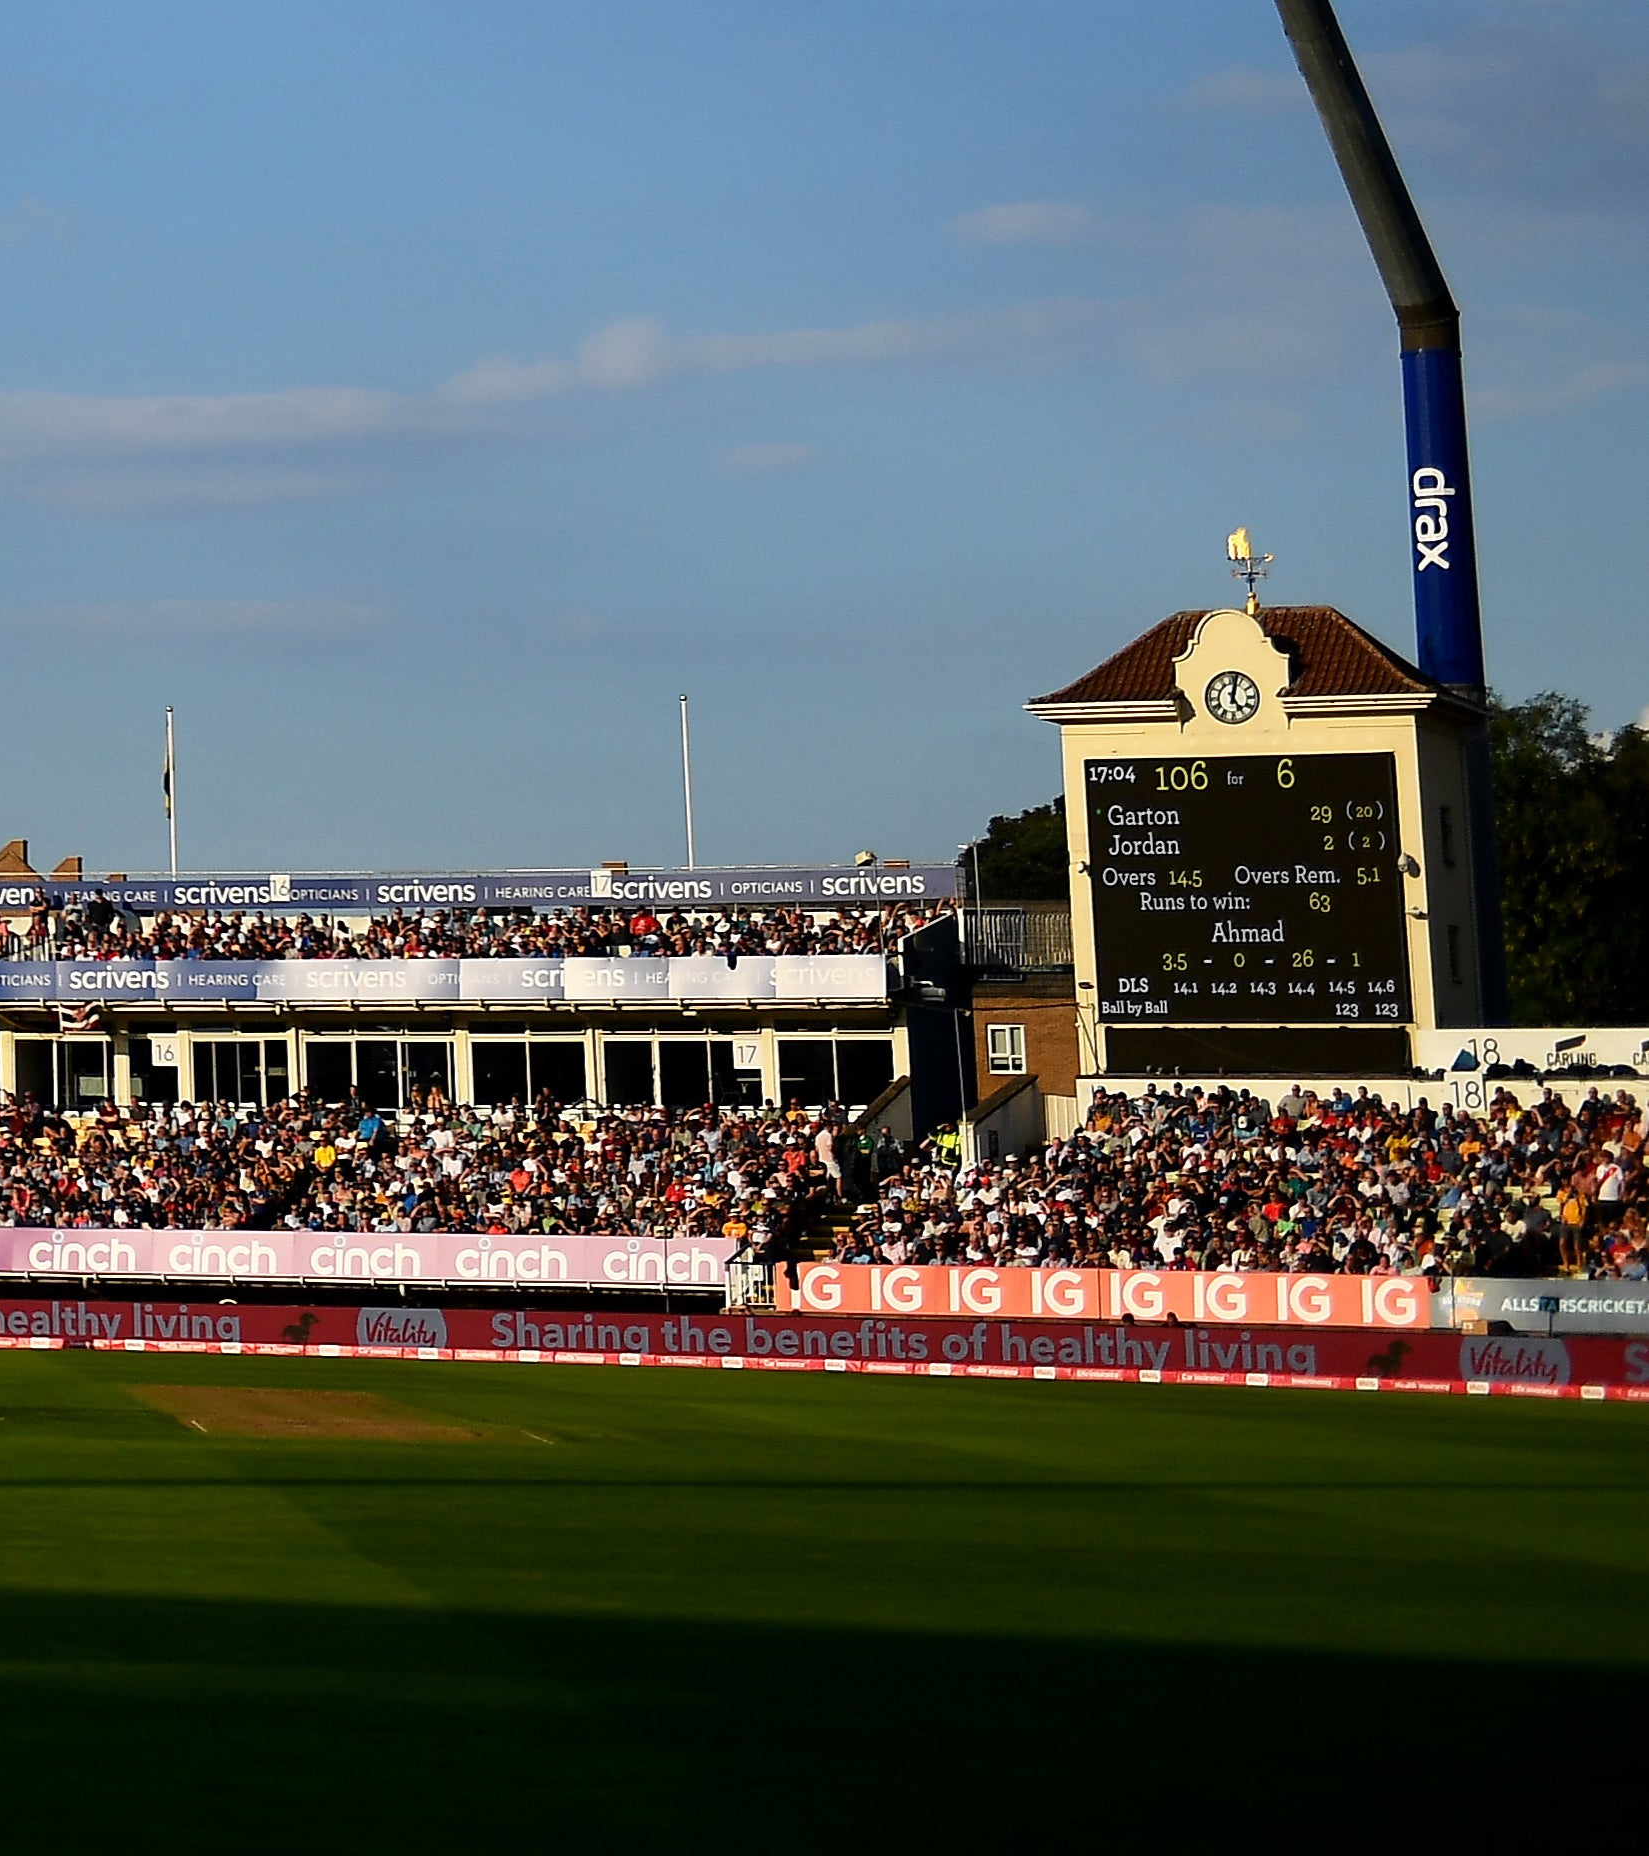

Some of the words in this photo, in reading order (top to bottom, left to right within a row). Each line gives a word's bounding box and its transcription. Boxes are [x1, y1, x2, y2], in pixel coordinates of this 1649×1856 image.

[1413, 467, 1455, 571] drax
[1089, 766, 1136, 784] 17:04
[1156, 761, 1208, 791] 106
[1227, 771, 1244, 785] for
[1276, 758, 1294, 788] 6
[1108, 804, 1180, 826] Garton
[1310, 806, 1332, 824] 29
[1108, 834, 1180, 856] Jordan
[1324, 836, 1334, 851] 2
[592, 875, 610, 893] 17
[821, 870, 925, 895] scrivens
[1102, 868, 1156, 887] Overs
[1168, 870, 1202, 888] 14.5
[1234, 865, 1289, 884] Overs
[1295, 866, 1340, 884] Rem.
[1357, 867, 1380, 885] 5.1
[124, 890, 156, 902] CARE
[174, 881, 270, 904] scrivens
[290, 888, 359, 901] OPTICIANS
[272, 879, 289, 897] 16
[377, 880, 476, 902] scrivens
[495, 886, 553, 898] HEARING
[557, 886, 590, 898] CARE
[612, 876, 712, 900] scrivens
[731, 881, 802, 895] OPTICIANS
[1140, 892, 1184, 911] Runs
[1190, 894, 1208, 910] to
[1213, 892, 1251, 910] win:
[1309, 892, 1331, 913] 63
[1212, 920, 1284, 943] Ahmad
[1162, 953, 1188, 971] 3.5
[1292, 949, 1314, 968] 26
[1352, 952, 1360, 967] 1
[69, 966, 169, 989] scrivens
[188, 974, 249, 986] HEARING
[1118, 978, 1149, 993] DLS
[1174, 981, 1198, 994] 14.1
[1211, 981, 1238, 995] 14.2
[1250, 981, 1276, 995] 14.3
[1288, 980, 1316, 996] 14.4
[1328, 980, 1356, 994] 14.5
[1368, 980, 1396, 994] 14.6
[1102, 1001, 1127, 1014] Ball
[1128, 1001, 1143, 1017] by
[1146, 1000, 1168, 1014] Ball
[1335, 1003, 1359, 1018] 123
[1374, 1003, 1399, 1018] 123
[1468, 1038, 1500, 1066] 18
[1546, 1052, 1596, 1066] CARLING
[1450, 1080, 1482, 1109] 18
[29, 1231, 136, 1272] cinch
[168, 1233, 276, 1274] cinch
[310, 1236, 421, 1276] cinch
[455, 1238, 568, 1279] cinch
[603, 1240, 717, 1282] cinch
[871, 1267, 922, 1311] IG
[949, 1268, 1001, 1314] IG
[1032, 1270, 1084, 1316] IG
[1110, 1272, 1163, 1320] IG
[1193, 1274, 1247, 1320] IG
[1276, 1276, 1332, 1322] IG
[1362, 1278, 1417, 1325] IG
[133, 1303, 240, 1342] living
[365, 1311, 438, 1346] Vitality
[492, 1311, 649, 1354] Sharing
[662, 1316, 732, 1354] the
[746, 1318, 927, 1360] benefits
[942, 1322, 986, 1362] of
[1002, 1324, 1169, 1371] healthy
[1184, 1329, 1316, 1376] living
[1468, 1340, 1558, 1382] Vitality
